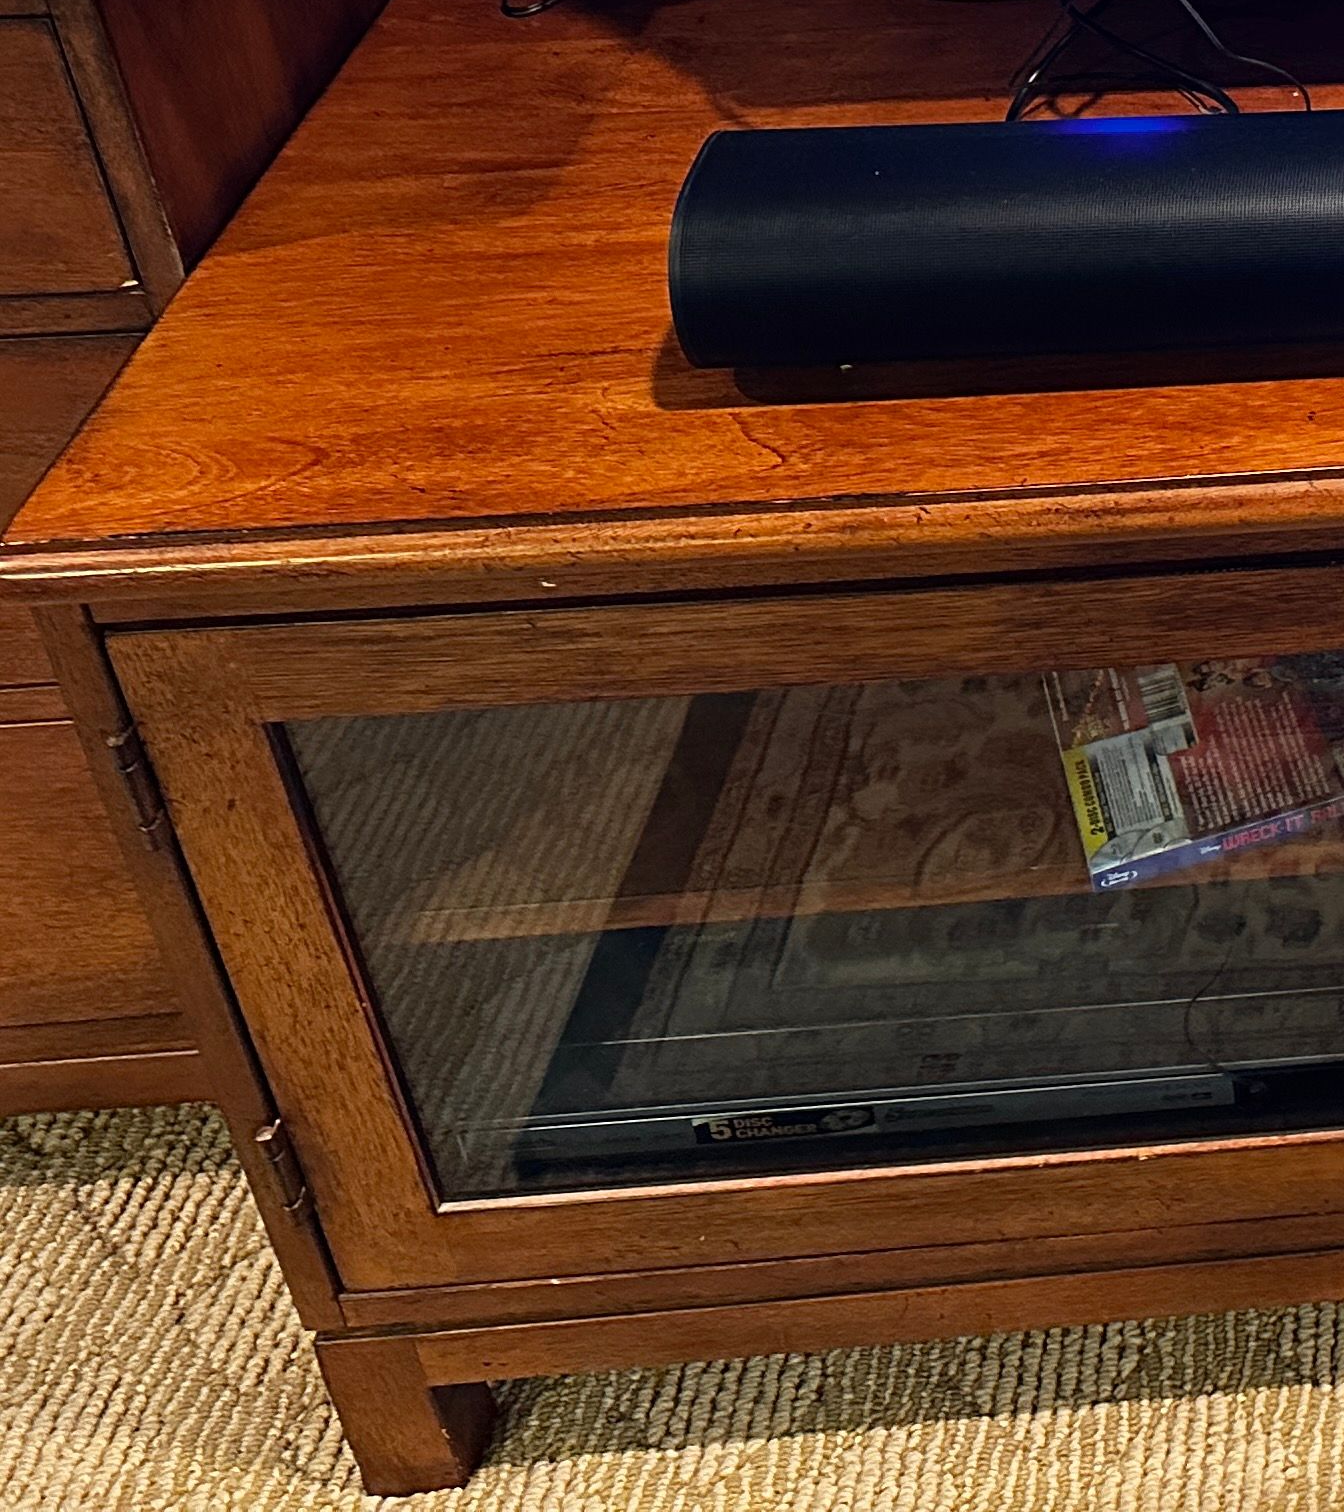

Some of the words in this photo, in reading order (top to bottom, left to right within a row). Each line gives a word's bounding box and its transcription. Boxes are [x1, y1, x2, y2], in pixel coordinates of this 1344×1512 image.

[708, 1119, 733, 1141] 5
[734, 1116, 773, 1129] DISC
[735, 1123, 818, 1139] CHANGER
